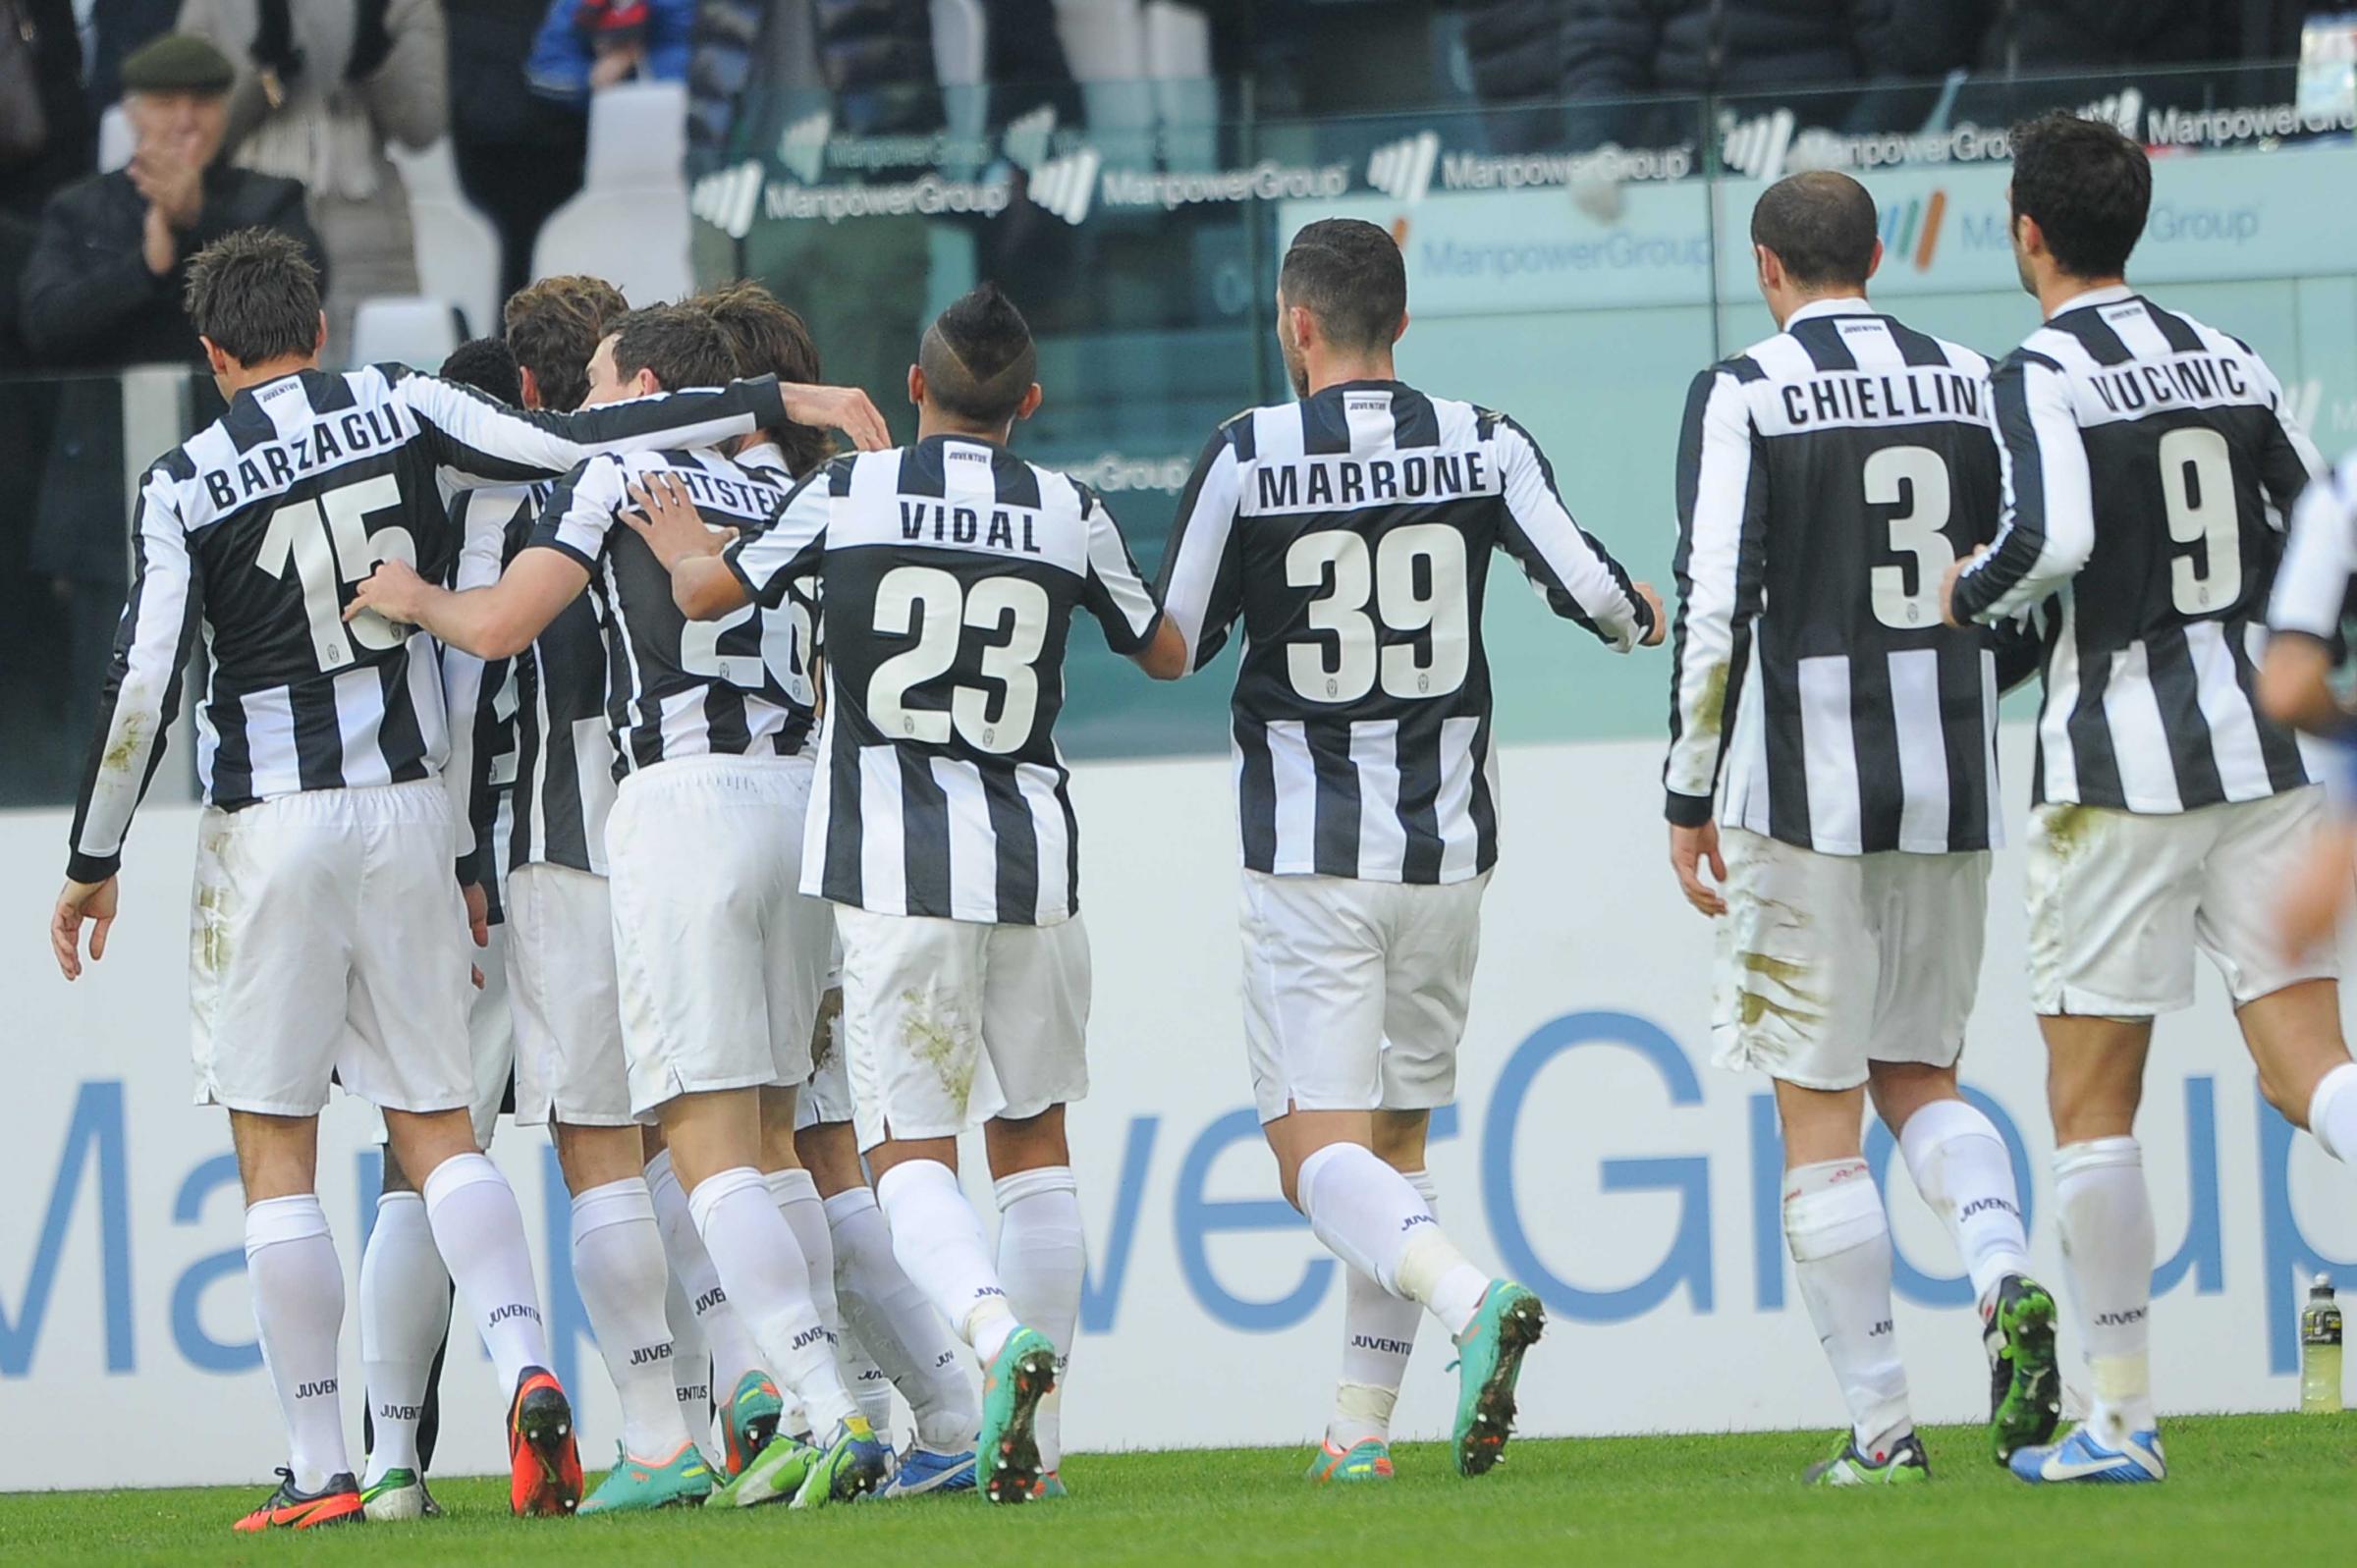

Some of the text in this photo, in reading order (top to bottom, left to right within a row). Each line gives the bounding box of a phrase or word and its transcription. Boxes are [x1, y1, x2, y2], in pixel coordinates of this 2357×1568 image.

[765, 172, 1009, 225] ManpowerGroup
[1781, 372, 1988, 425] CHIELLIN
[204, 402, 404, 512] BARZAGLI
[1257, 452, 1488, 509] MARRONE
[254, 472, 418, 674] 15
[900, 501, 1042, 555] VIDAL
[1863, 445, 1955, 630] 3
[2160, 427, 2242, 616] 9
[866, 566, 1050, 755] 23
[1286, 522, 1470, 704] 39
[675, 1384, 708, 1402] ENTUS
